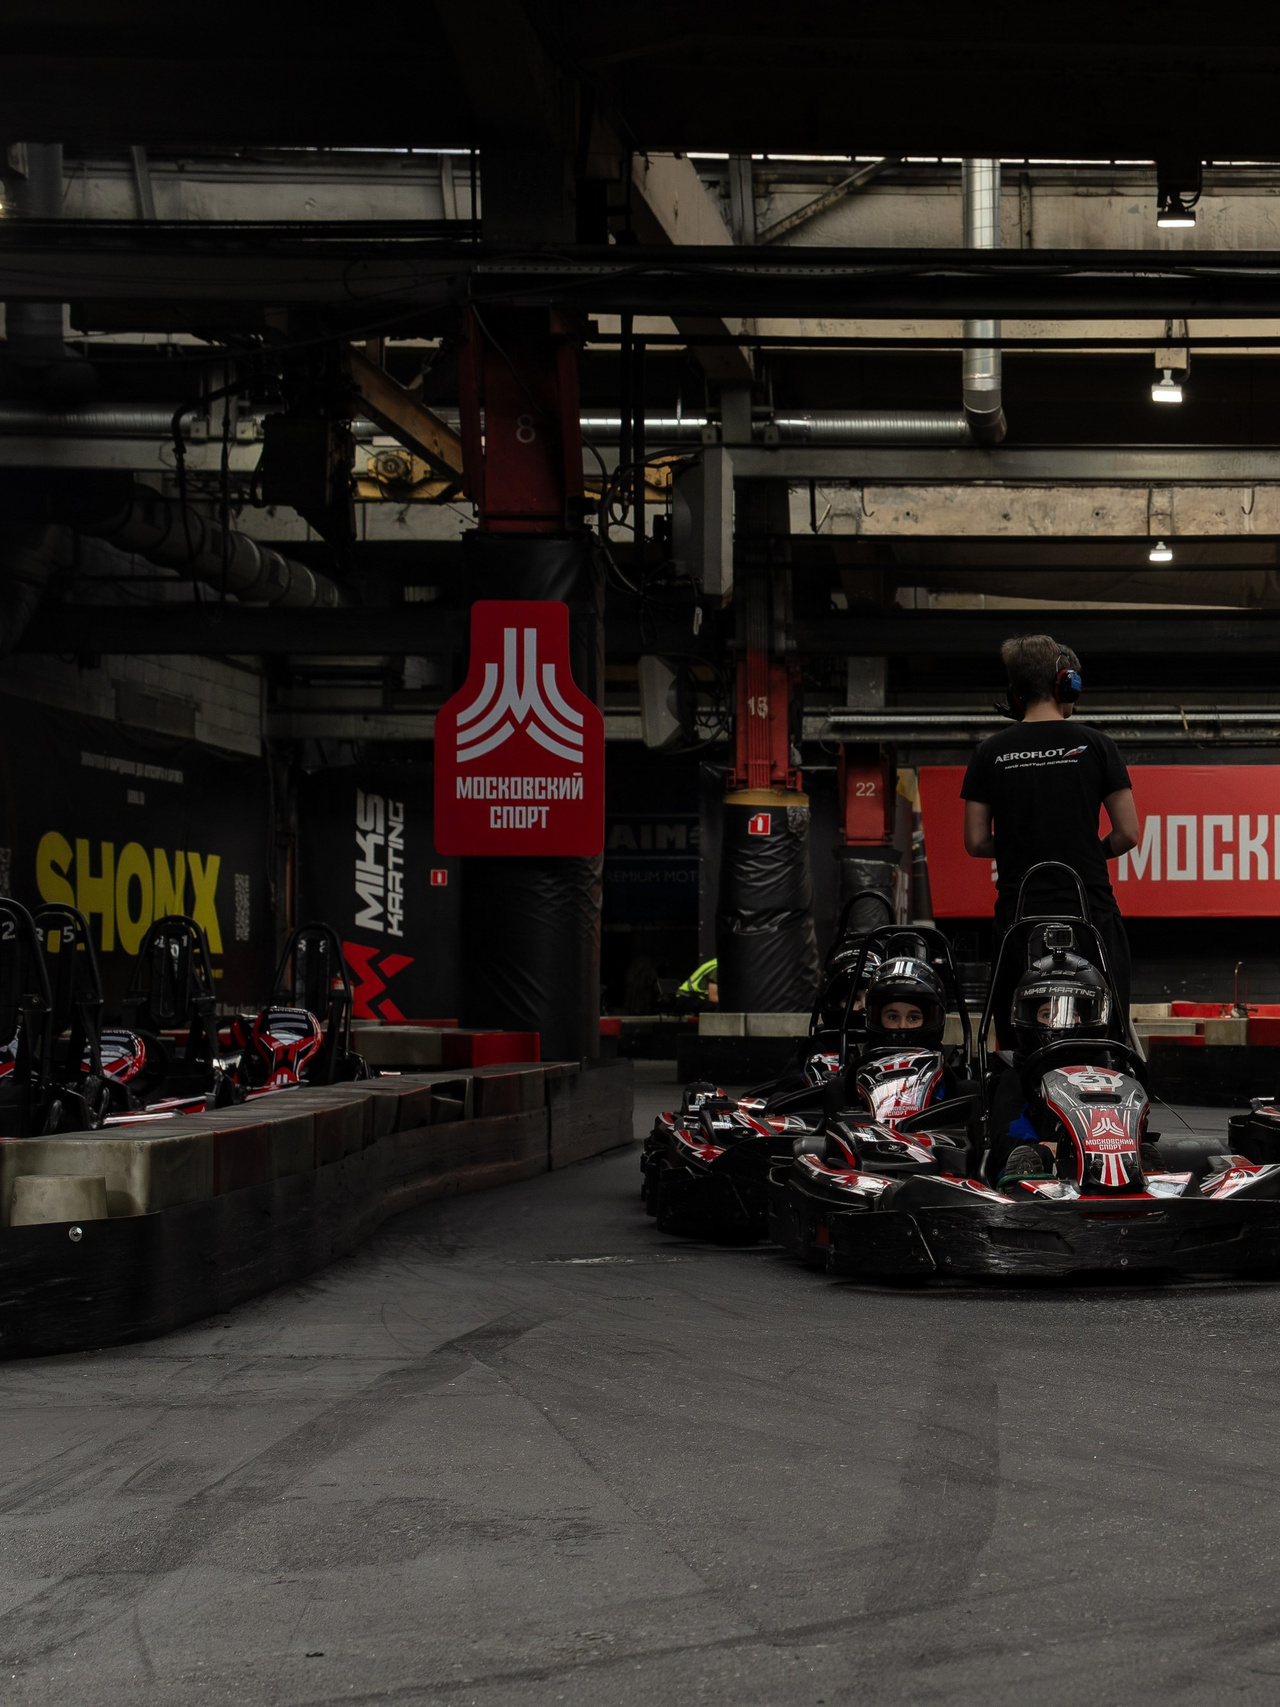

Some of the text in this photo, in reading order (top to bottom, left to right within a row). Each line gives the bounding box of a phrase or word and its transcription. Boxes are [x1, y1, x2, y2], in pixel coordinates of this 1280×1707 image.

[516, 414, 536, 443] 8
[995, 748, 1065, 764] AEROFLOT
[456, 772, 584, 800] МОСКОВСКИЙ
[856, 782, 876, 796] 22
[490, 806, 550, 829] СПОРТ
[355, 788, 385, 932] MIKS
[387, 798, 404, 938] KARTING
[36, 831, 224, 956] SHONX
[1048, 986, 1096, 997] KARTING
[1078, 1075, 1113, 1085] 31
[1085, 1138, 1134, 1146] МОСКОВСКИЙ
